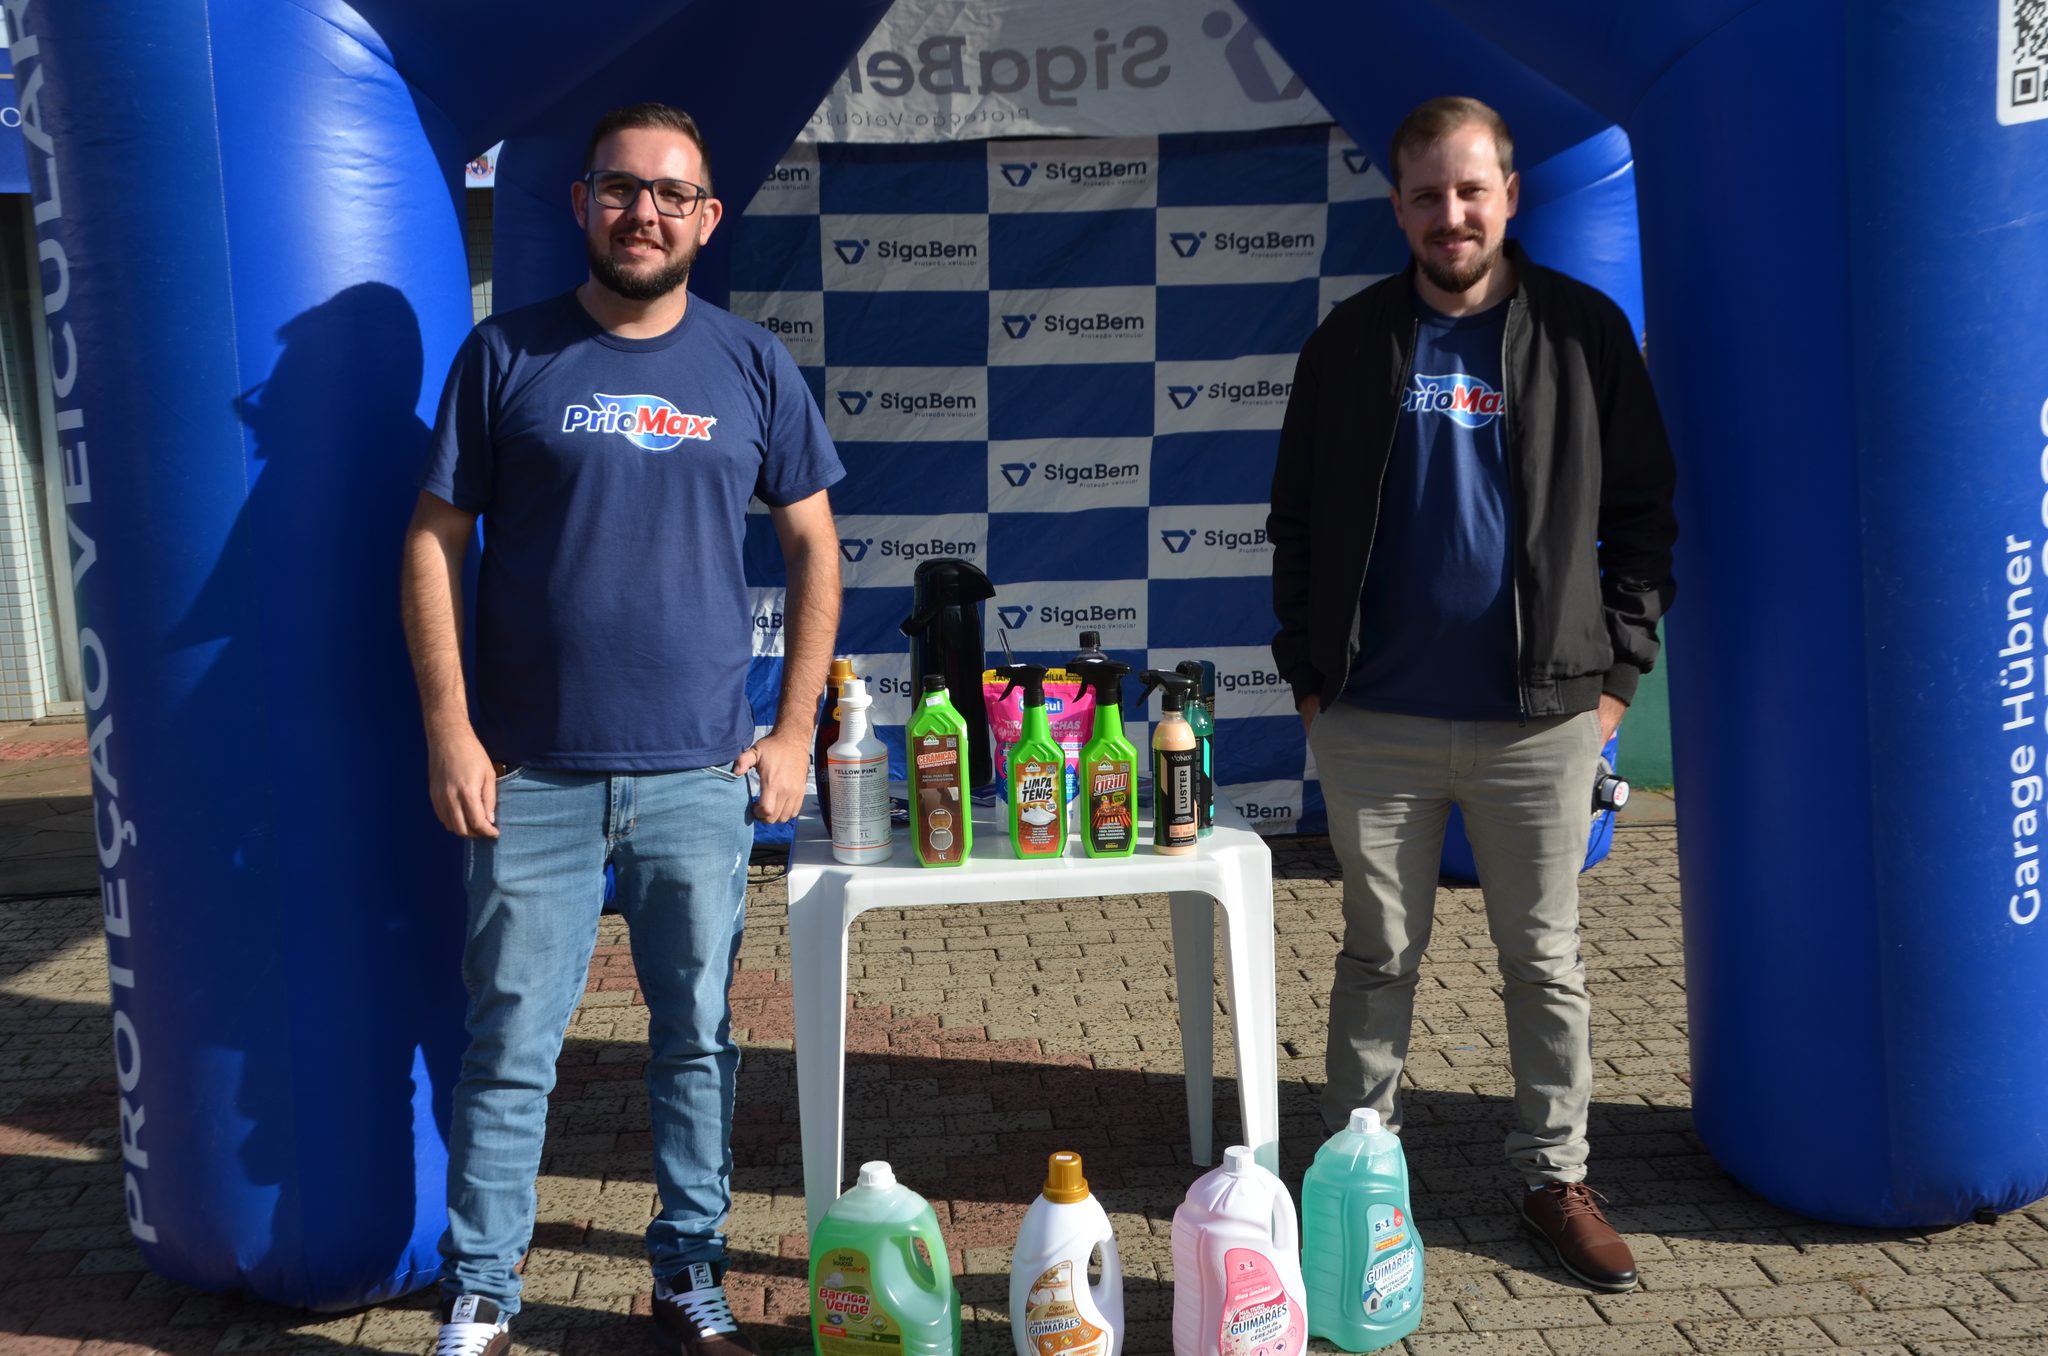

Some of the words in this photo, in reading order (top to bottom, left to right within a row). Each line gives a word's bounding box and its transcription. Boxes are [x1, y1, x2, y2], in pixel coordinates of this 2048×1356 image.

[1045, 161, 1148, 184] SigaBem
[878, 240, 978, 263] SigaBem
[1214, 231, 1315, 254] SigaBem
[1044, 313, 1144, 336] SigaBem
[880, 392, 977, 414] SigaBem
[562, 403, 713, 440] PrioMax
[1044, 463, 1139, 485] SigaBem
[880, 539, 976, 560] SigaBem
[1204, 529, 1270, 550] SigaB
[1040, 605, 1136, 627] SigaBem
[1998, 532, 2037, 732] Hübner
[834, 768, 860, 776] YELLOW
[861, 767, 878, 775] PINE
[1023, 777, 1052, 790] LIMPA
[1179, 769, 1188, 810] LUSTER
[2006, 745, 2044, 926] Garage
[819, 1287, 867, 1305] Barriga
[1230, 1303, 1288, 1336] GUIMARÃES
